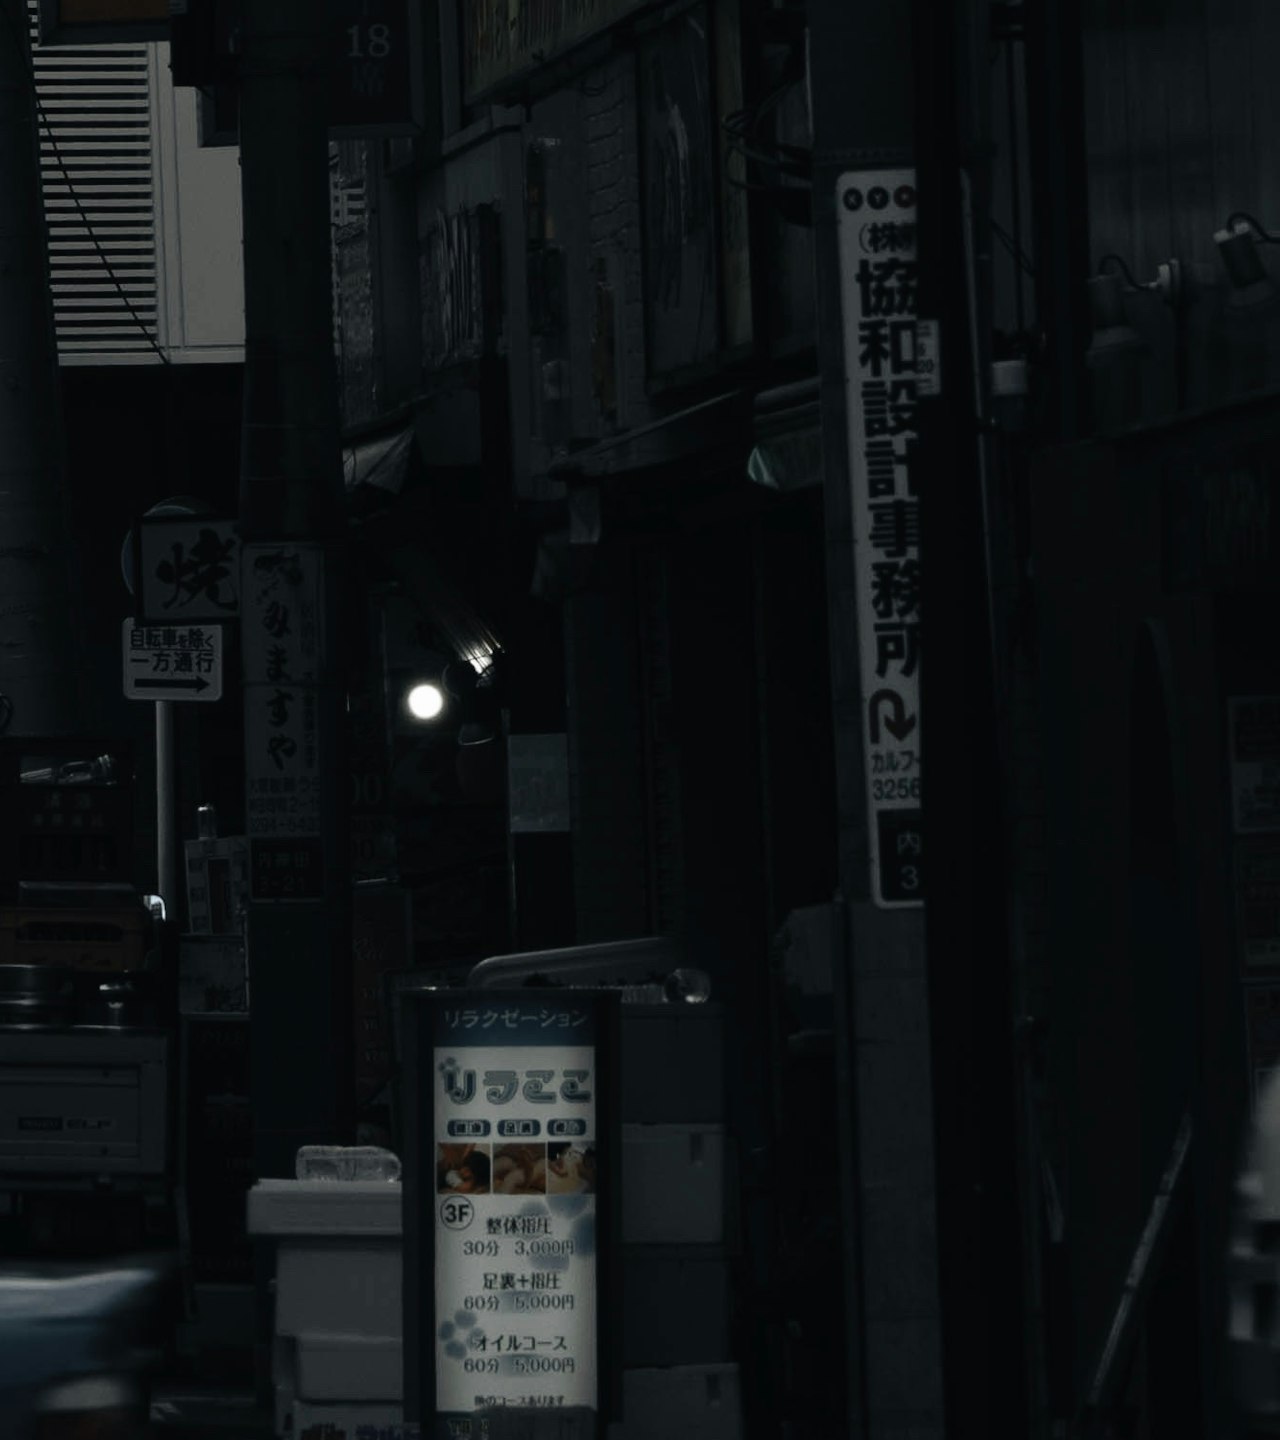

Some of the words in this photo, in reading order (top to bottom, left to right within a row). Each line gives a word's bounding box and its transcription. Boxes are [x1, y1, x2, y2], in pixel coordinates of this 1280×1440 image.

[130, 627, 214, 650] 自転車を除く
[130, 650, 215, 673] 一方通行
[443, 1008, 588, 1029] リラクゼーション
[443, 1203, 471, 1223] 3F
[486, 1216, 553, 1235] 整体指圧
[463, 1240, 500, 1257] 30分
[513, 1239, 575, 1257] 3,000円
[463, 1294, 500, 1311] 60分
[514, 1293, 575, 1311] 5,000円
[474, 1334, 568, 1352] オイルコース
[463, 1356, 500, 1374] 60分
[514, 1356, 575, 1374] 5,000円
